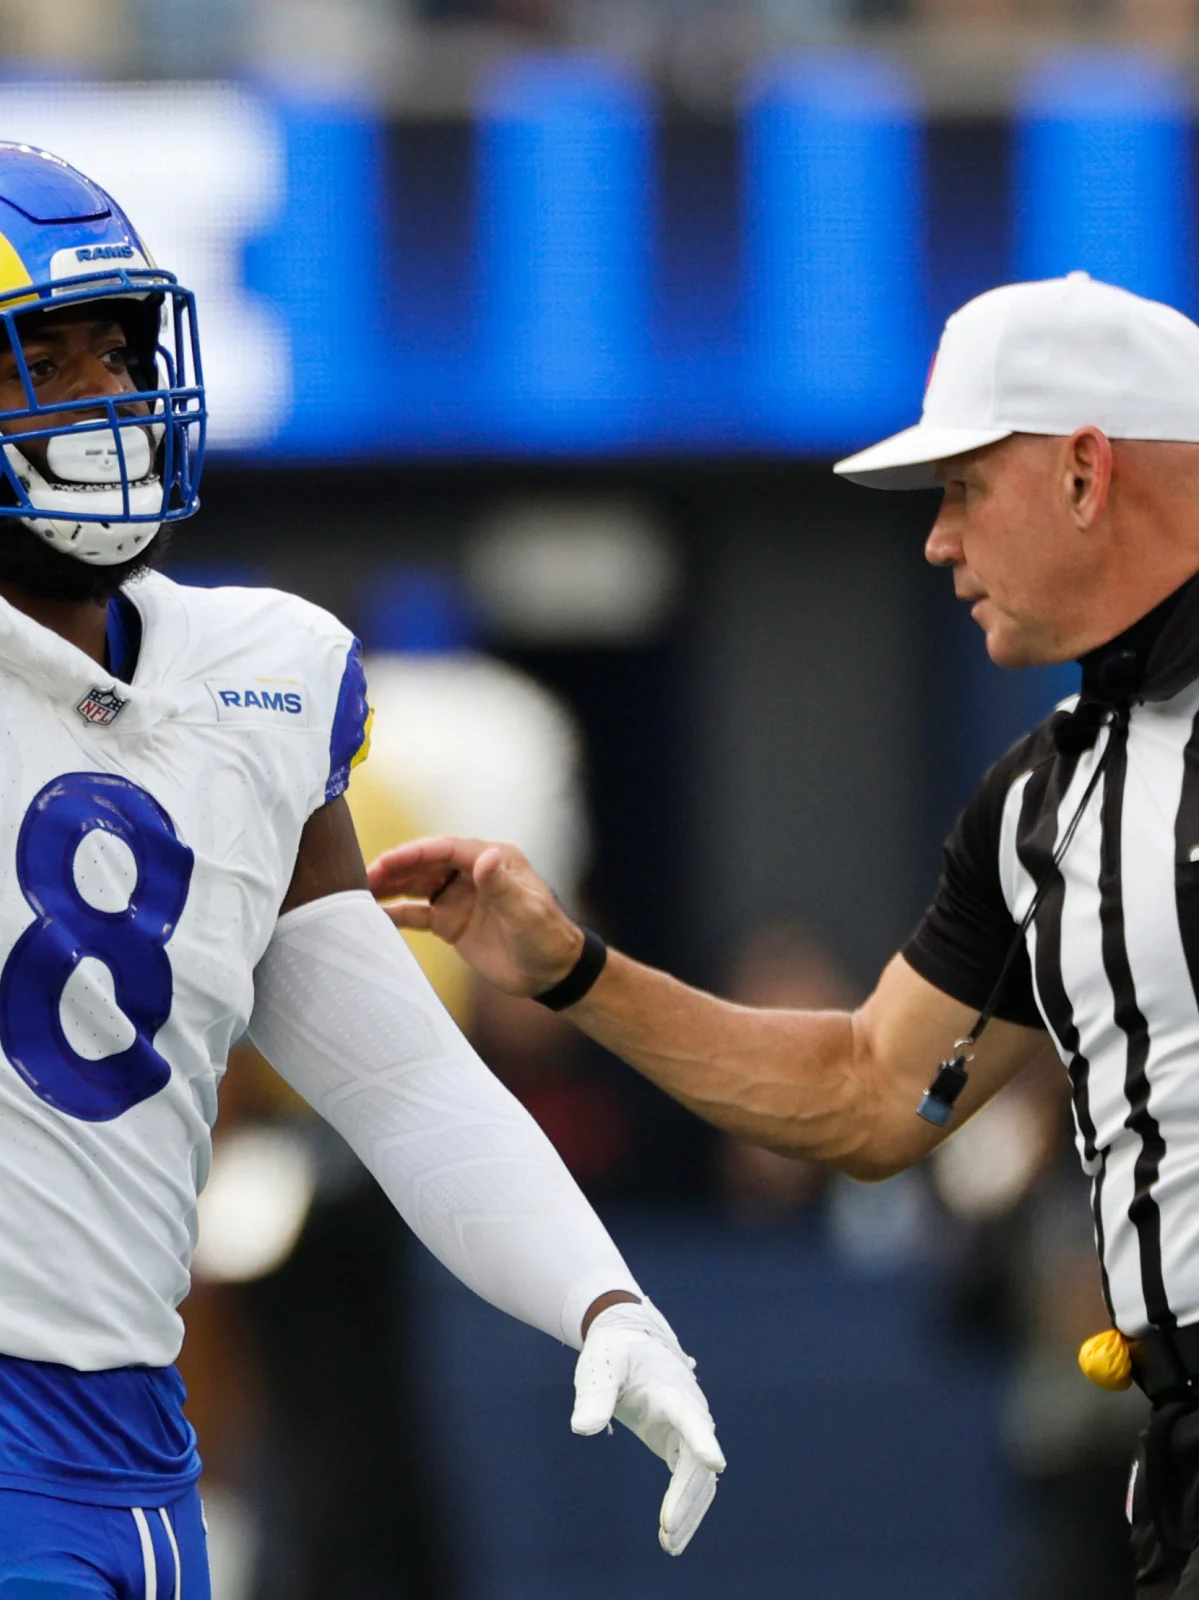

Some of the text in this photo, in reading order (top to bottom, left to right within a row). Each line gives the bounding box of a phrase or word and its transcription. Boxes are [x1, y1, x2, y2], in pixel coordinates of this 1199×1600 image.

[76, 246, 134, 262] RAMS
[80, 700, 112, 723] NFL
[218, 690, 302, 714] RAMS
